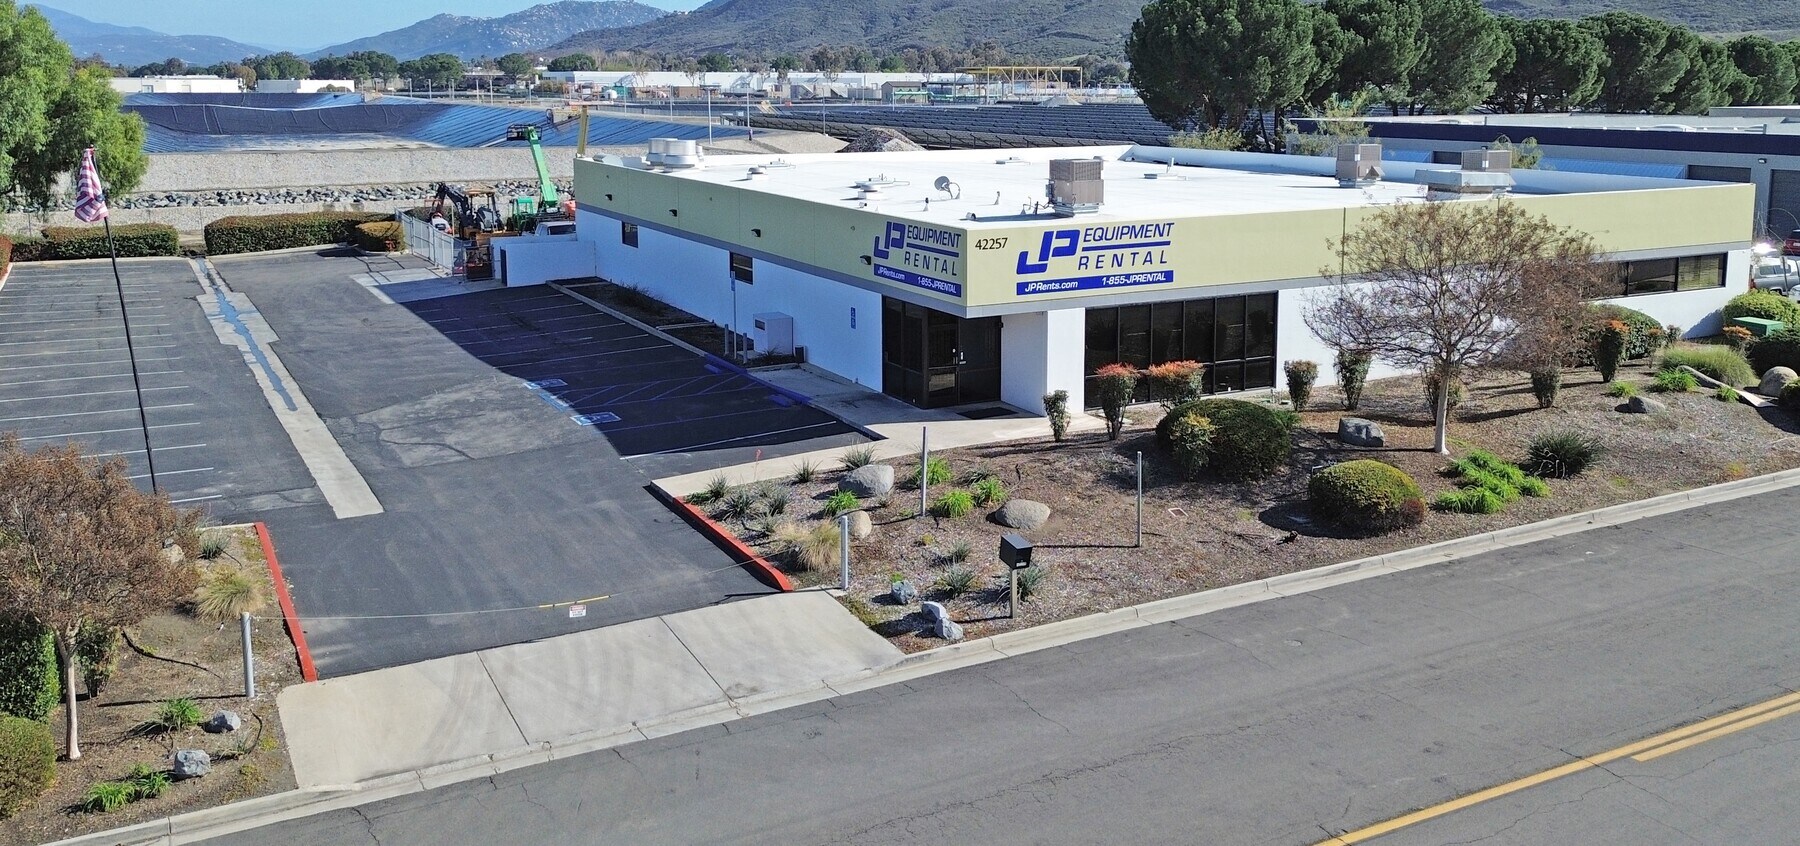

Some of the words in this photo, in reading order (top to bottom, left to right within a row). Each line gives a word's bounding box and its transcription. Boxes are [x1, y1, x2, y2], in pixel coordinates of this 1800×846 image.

[874, 221, 906, 259] JP
[907, 225, 961, 248] EQUIPMENT
[975, 238, 1008, 250] 42257
[1083, 223, 1174, 243] EQUIPMENT
[904, 251, 957, 276] RENTAL
[1016, 230, 1080, 274] JP
[1078, 250, 1168, 270] RENTAL
[877, 266, 905, 281] JPRents.com
[917, 276, 956, 293] 1-855-JPRENTAL
[1025, 280, 1078, 292] JPRents.com
[1102, 272, 1166, 286] 1-855-JPRENTAL
